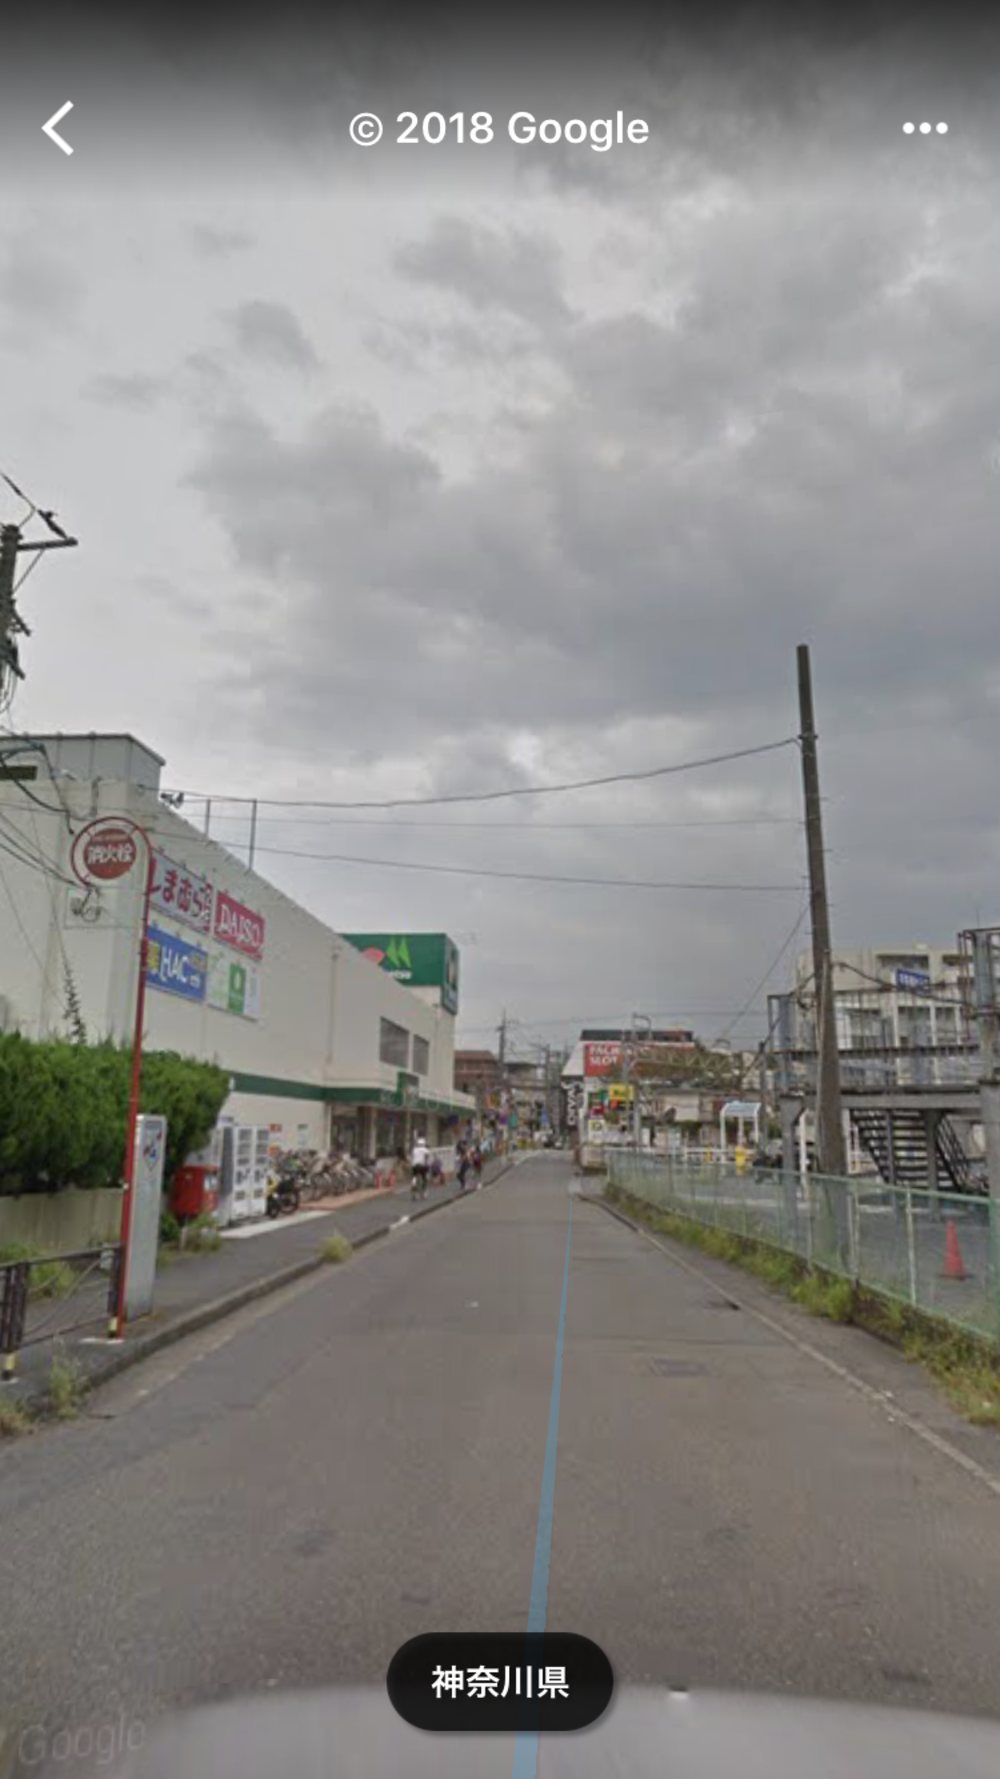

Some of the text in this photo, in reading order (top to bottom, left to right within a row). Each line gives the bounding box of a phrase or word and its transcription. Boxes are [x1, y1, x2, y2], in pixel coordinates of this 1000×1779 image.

[87, 843, 132, 865] 消火栓
[218, 903, 262, 949] DAISO
[160, 946, 190, 984] HAC
